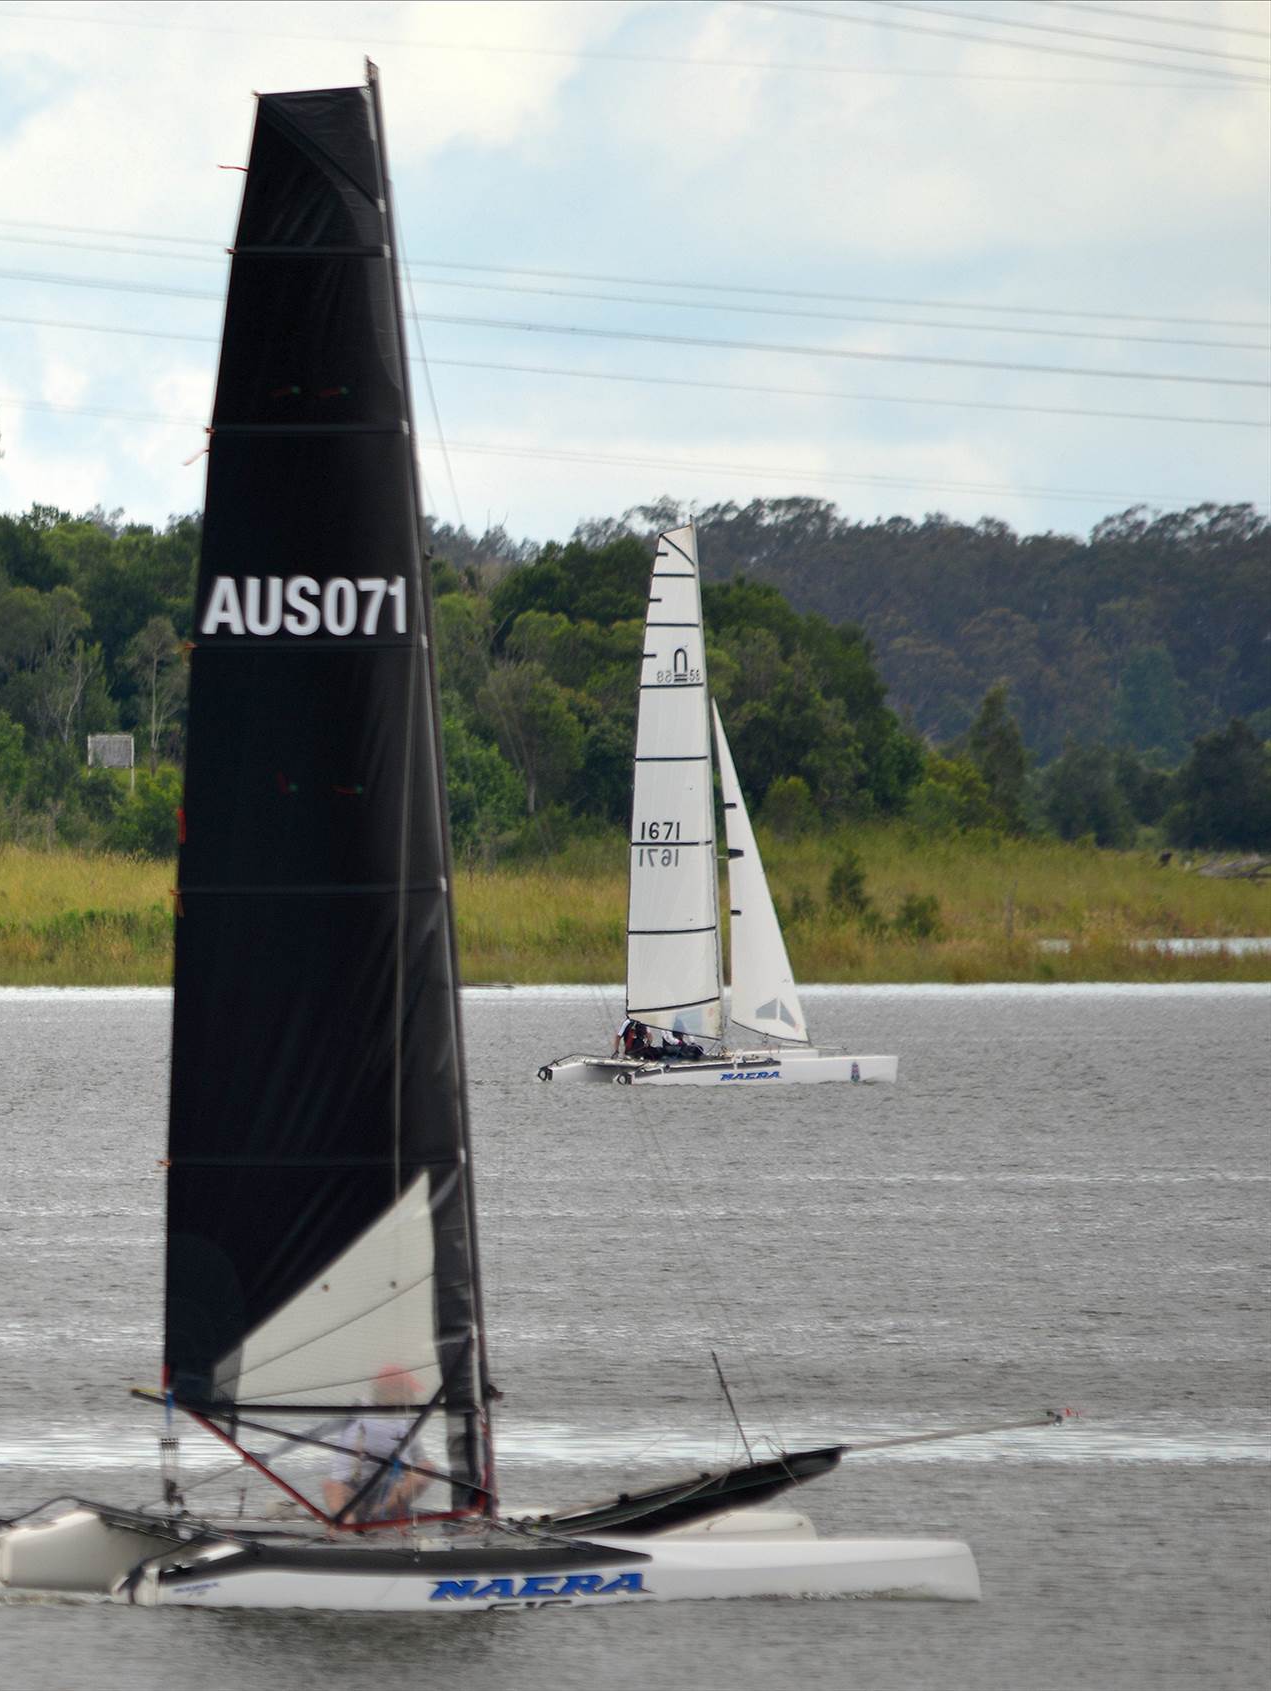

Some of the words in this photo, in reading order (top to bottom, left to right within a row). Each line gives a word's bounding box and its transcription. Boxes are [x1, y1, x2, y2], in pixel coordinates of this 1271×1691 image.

[201, 575, 407, 637] AUS071
[641, 821, 681, 841] 1671
[427, 1573, 654, 1600] NACRA
